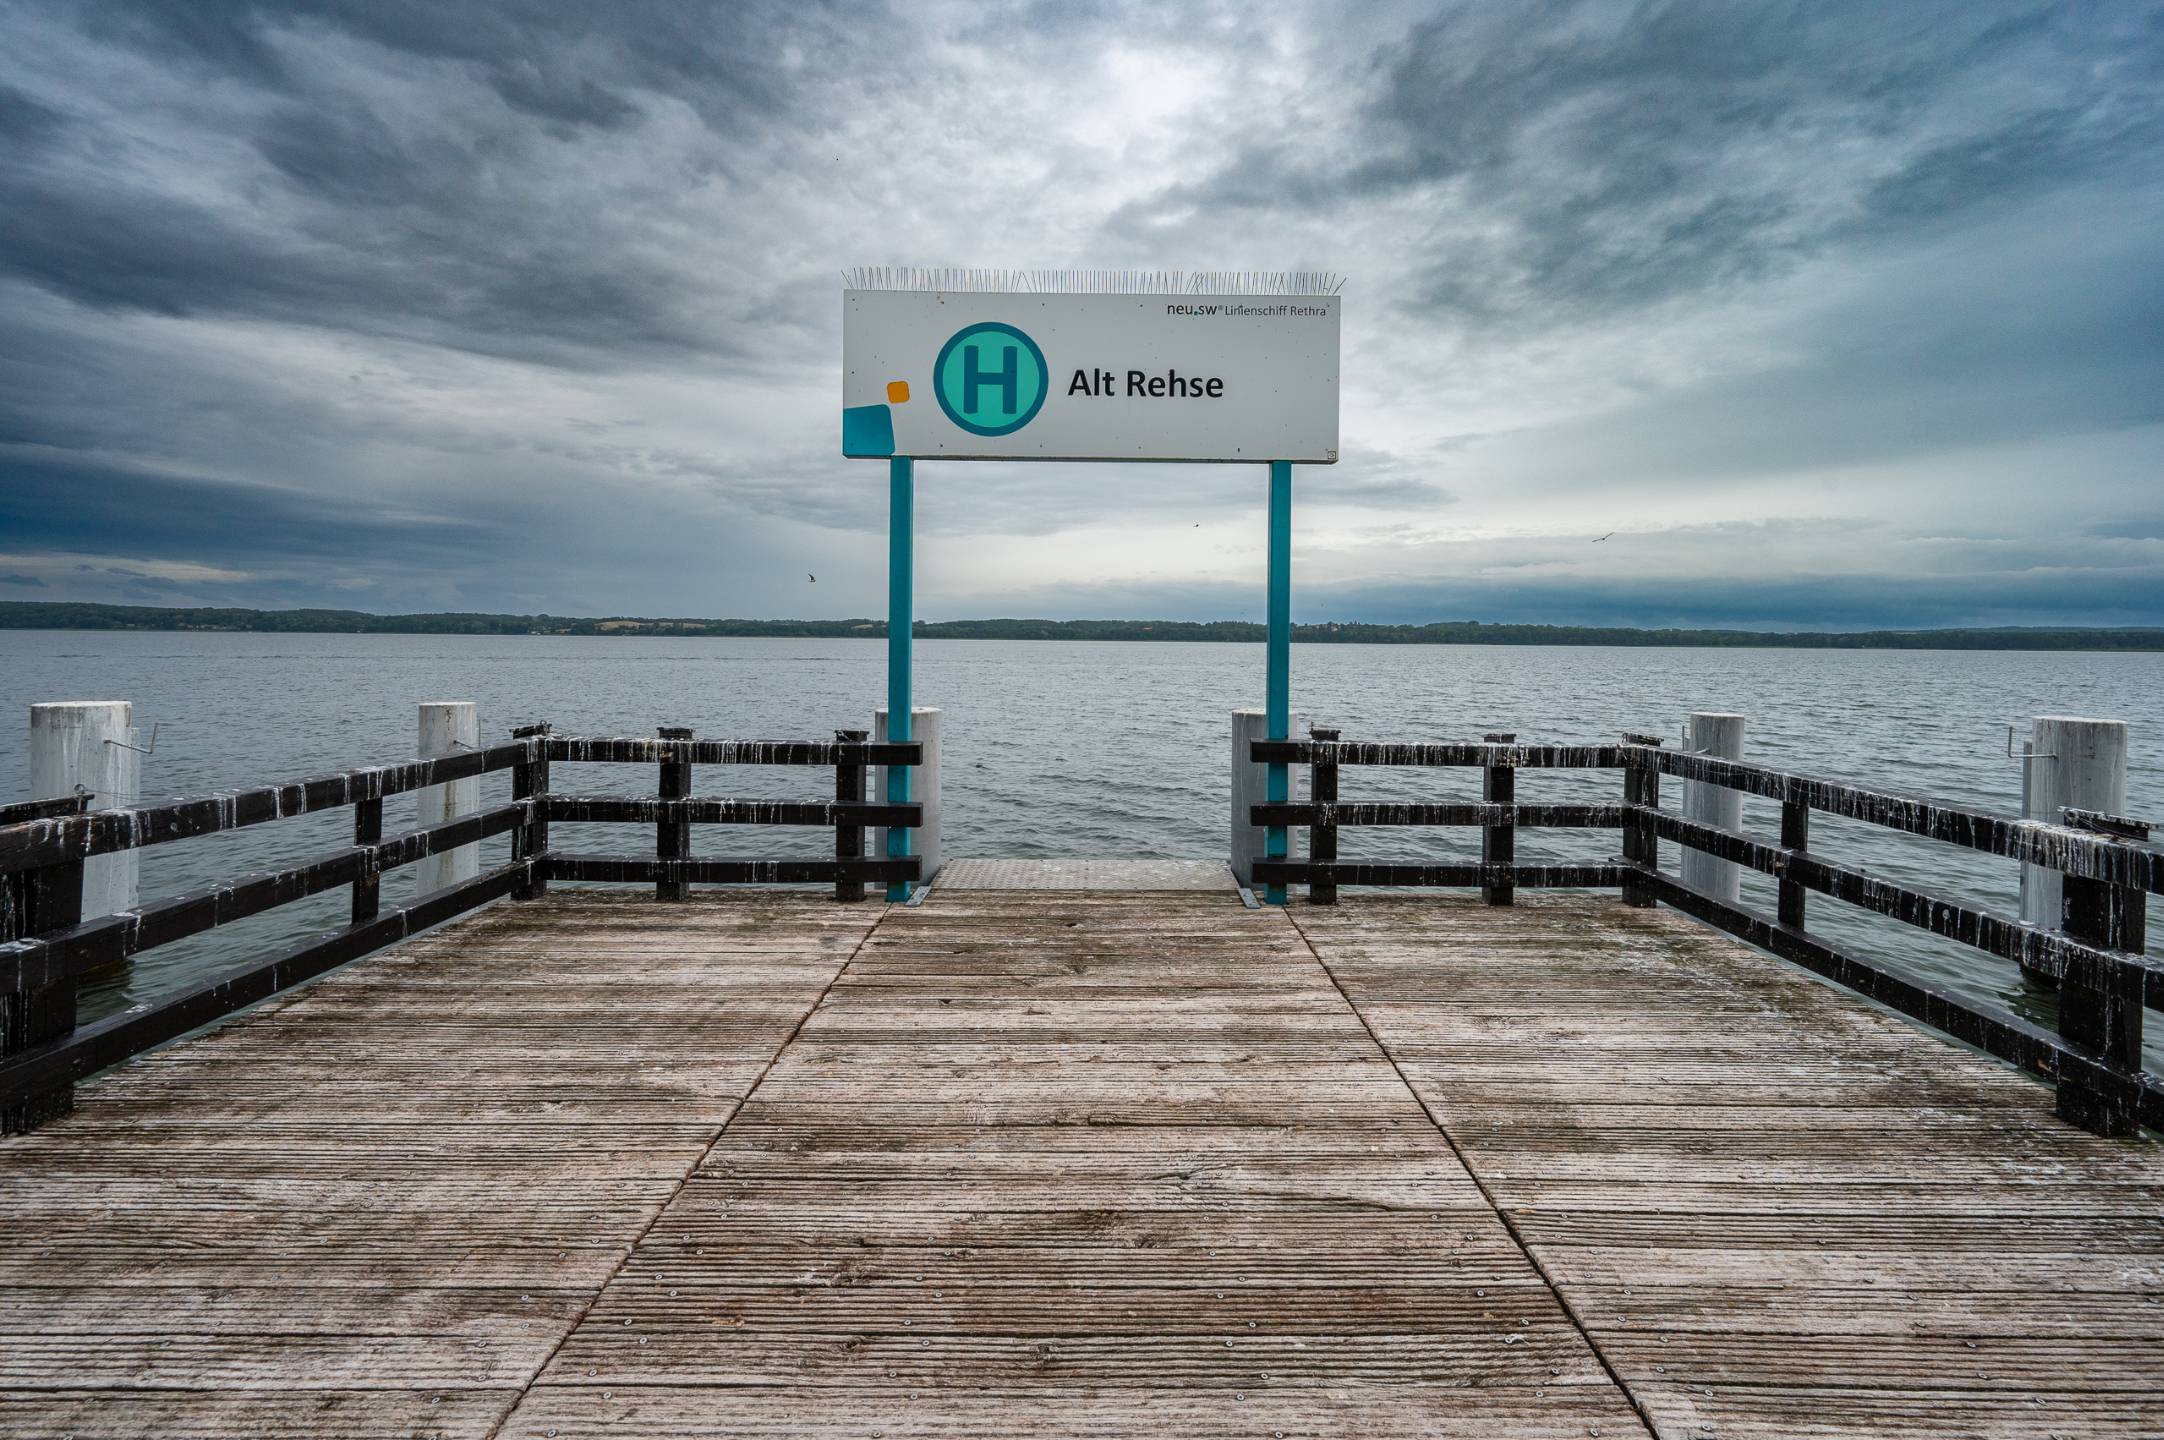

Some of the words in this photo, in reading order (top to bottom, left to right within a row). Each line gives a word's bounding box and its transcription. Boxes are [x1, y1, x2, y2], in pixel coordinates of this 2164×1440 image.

[1225, 305, 1288, 316] Linienschiff
[1290, 305, 1326, 316] Rethra
[963, 345, 1017, 414] H
[1067, 368, 1116, 397] Alt
[1127, 369, 1224, 398] Rehse
